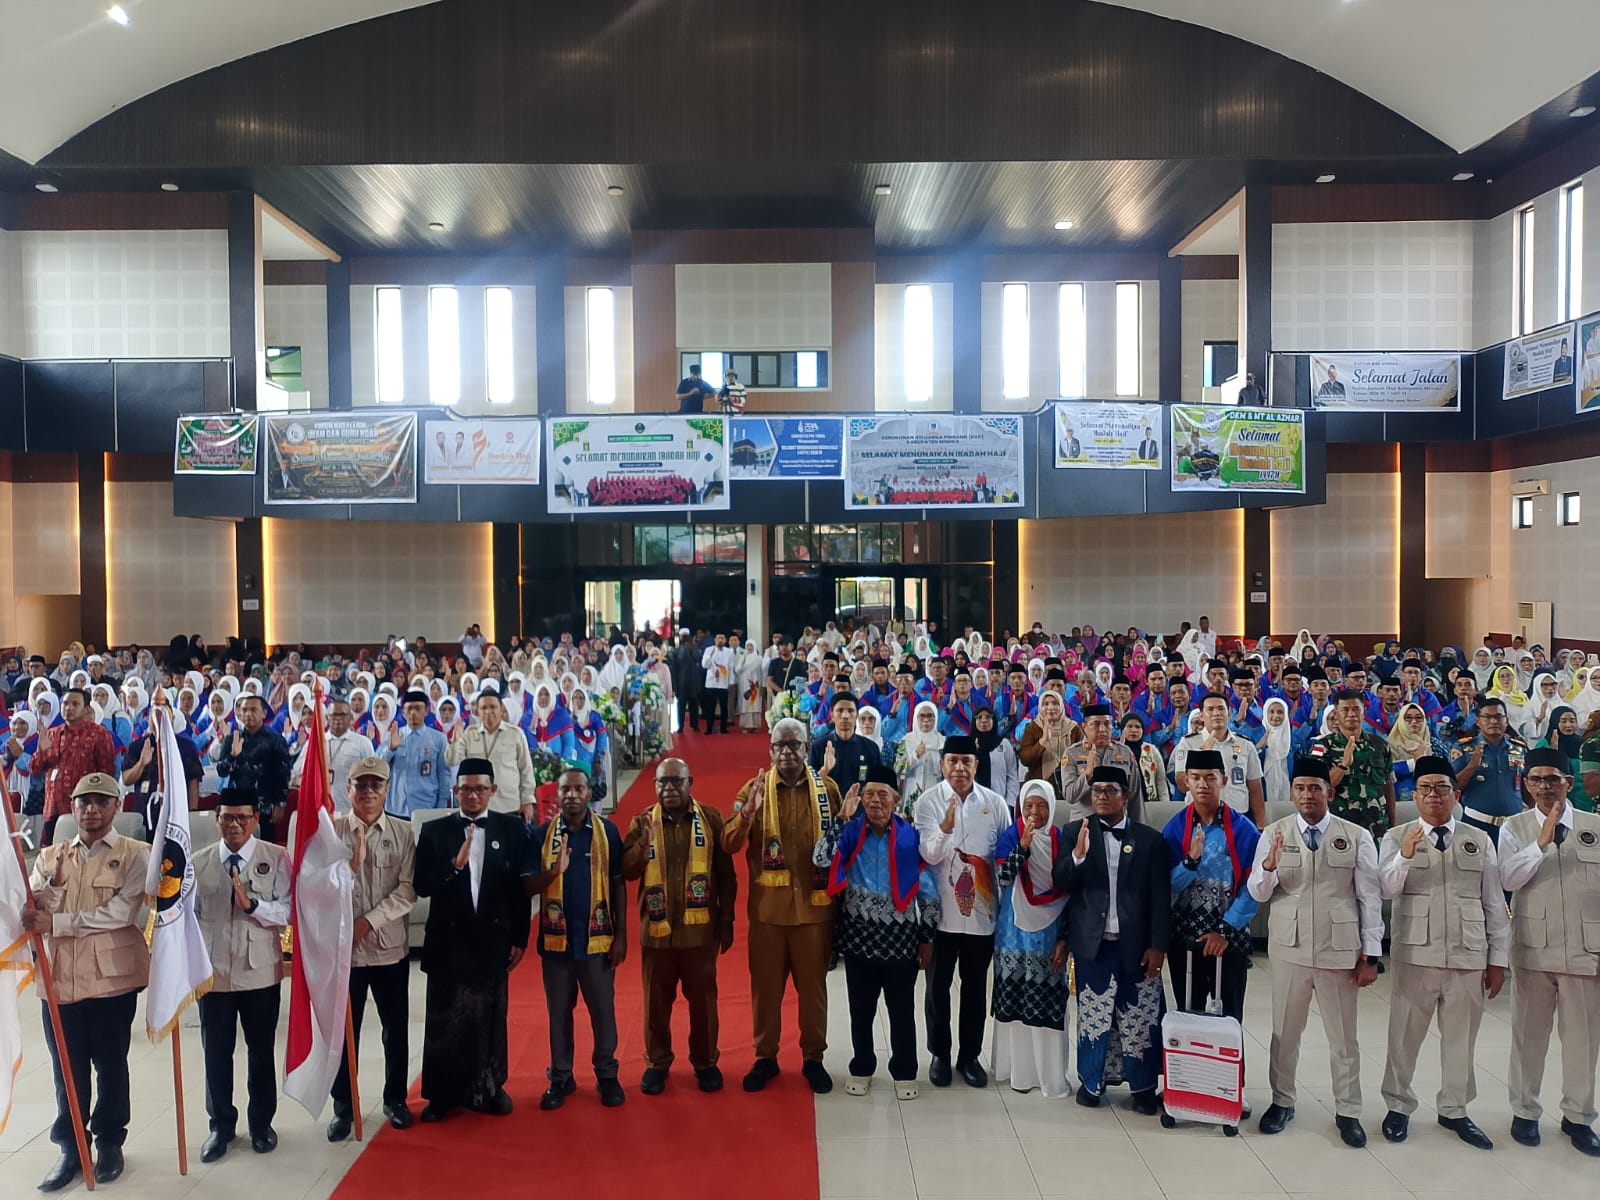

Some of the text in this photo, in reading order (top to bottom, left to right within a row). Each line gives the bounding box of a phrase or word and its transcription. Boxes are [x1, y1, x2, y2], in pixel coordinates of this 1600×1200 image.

[1351, 368, 1449, 386] Selamat Jalan
[1229, 411, 1246, 419] DKM
[1254, 412, 1265, 420] MT
[1265, 413, 1275, 421] AL
[1276, 414, 1300, 422] AZHAR
[1238, 427, 1281, 442] Selamat
[575, 453, 608, 463] SELAMAT
[610, 452, 657, 462] MENUNAIKAN
[686, 450, 700, 463] HAJI
[861, 451, 898, 459] SELAMAT
[987, 450, 1006, 458] HAJI
